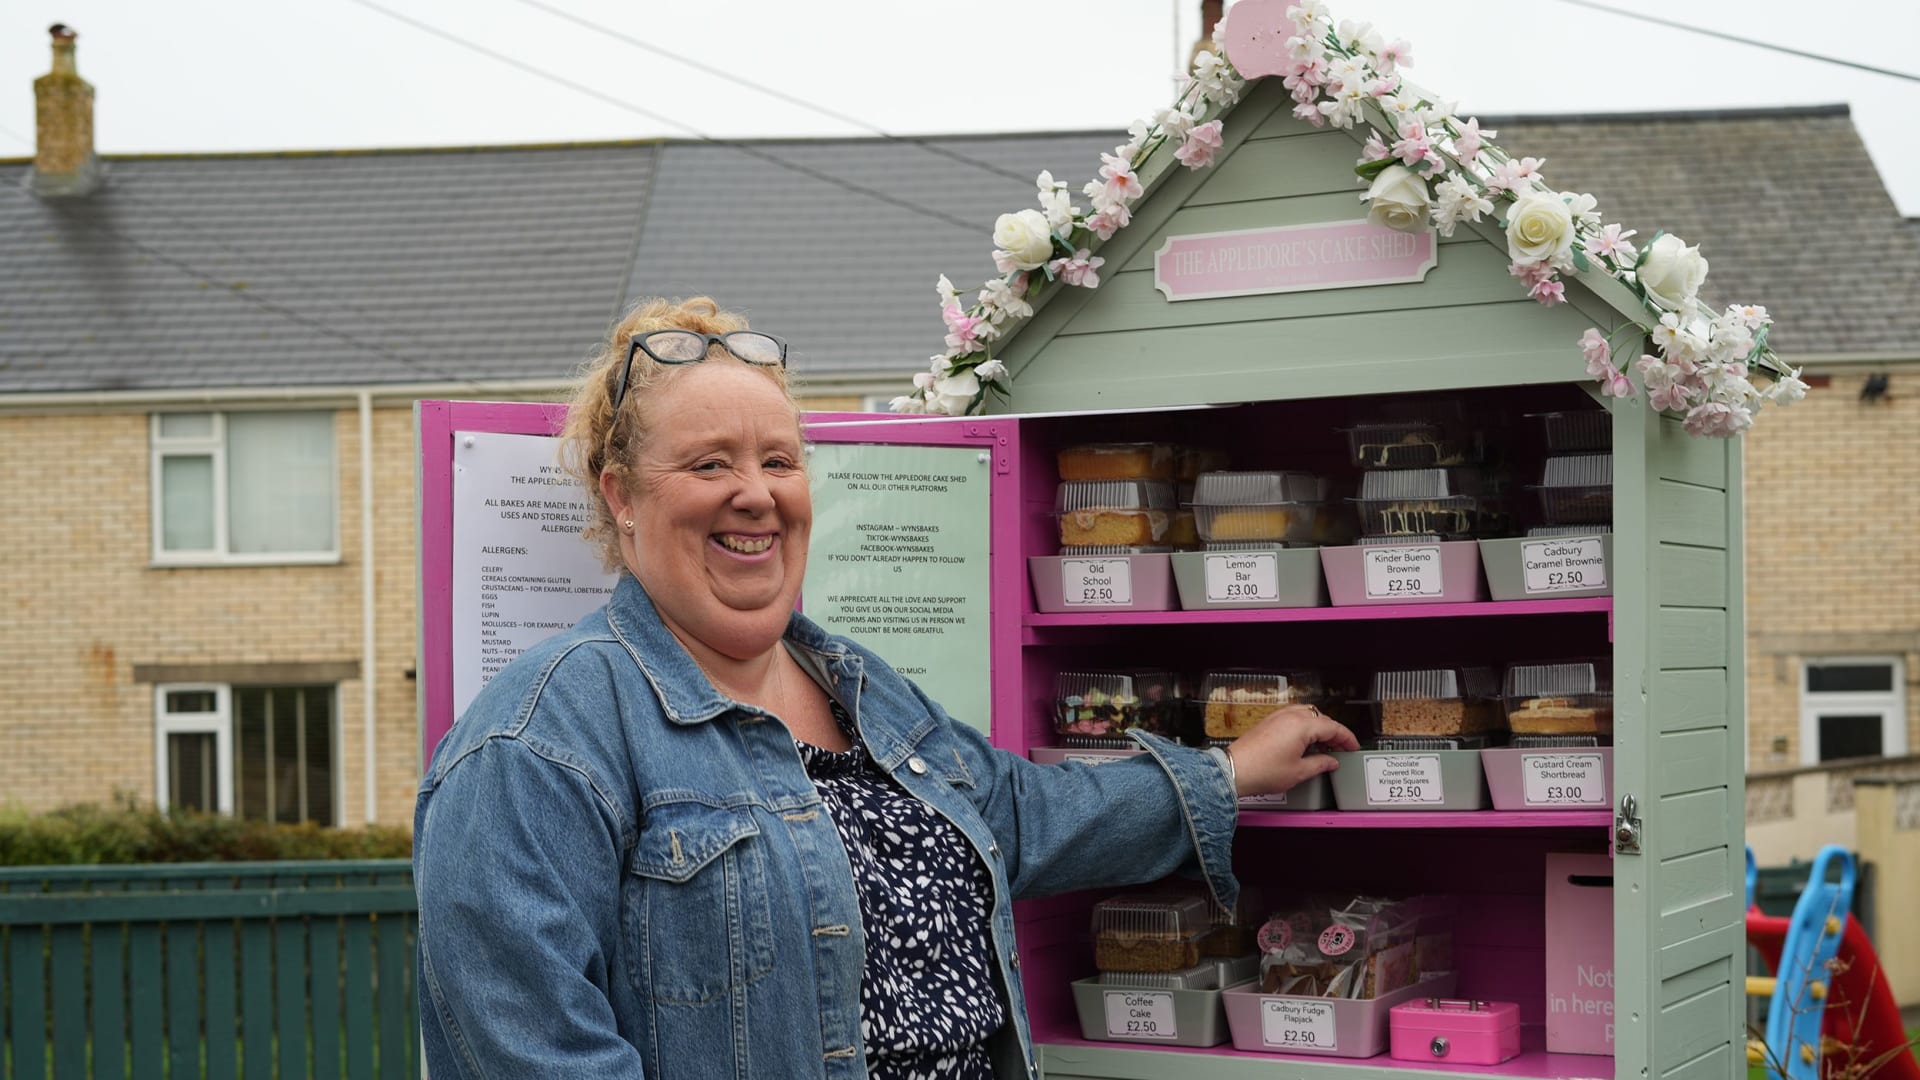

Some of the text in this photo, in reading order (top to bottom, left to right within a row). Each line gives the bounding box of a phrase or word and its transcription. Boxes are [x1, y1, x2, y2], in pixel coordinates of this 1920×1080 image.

[1172, 233, 1416, 277] THE APPLEDORE'S CAKE SHED
[511, 476, 526, 485] THE
[528, 477, 572, 487] APPLEDORE
[827, 472, 851, 480] PLEASE
[894, 474, 931, 482] APPLEDORE
[888, 484, 910, 492] OTHER
[485, 499, 498, 507] ALL
[500, 499, 525, 508] BAKES
[527, 500, 542, 508] ARE
[544, 501, 567, 509] MADE
[569, 502, 578, 510] IN
[500, 511, 520, 519] USES
[522, 512, 540, 520] AND
[541, 512, 570, 521] STORES
[571, 513, 584, 522] ALL
[856, 524, 894, 532] INSTAGRAM
[866, 535, 929, 543] TIKTOK-WYNSBAKES
[481, 546, 528, 555] ALLERGENS:
[860, 545, 935, 553] FACEBOOK-WYNSBAKES
[1544, 546, 1582, 556] Cadbury
[872, 555, 901, 563] ALREADY
[1375, 554, 1430, 563] Kinder Bueno
[1527, 556, 1602, 570] Caramel Brownie
[1089, 565, 1104, 573] Old
[1226, 560, 1256, 569] Lemon
[1387, 565, 1420, 573] Brownie
[508, 576, 546, 584] CONTAINING
[1083, 576, 1111, 586] School
[1236, 572, 1251, 581] Bar
[1549, 571, 1582, 584] £2.50
[1227, 584, 1258, 595] £3.00
[1388, 580, 1420, 591] £2.50
[1083, 589, 1112, 600] £2.50
[1533, 760, 1592, 769] Custard Cream
[1541, 771, 1585, 779] Shortbread
[1379, 777, 1401, 785] Krispie
[1389, 787, 1421, 797] £2.50
[1548, 787, 1581, 798] £3.00
[1126, 997, 1153, 1006] Coffee
[1551, 994, 1566, 1012] in
[1130, 1009, 1151, 1018] Cake
[1271, 1004, 1325, 1016] Cadbury Fudge
[1284, 1014, 1312, 1024] Flapjack
[1127, 1021, 1156, 1032] £2.50
[1284, 1030, 1315, 1042] £2.50
